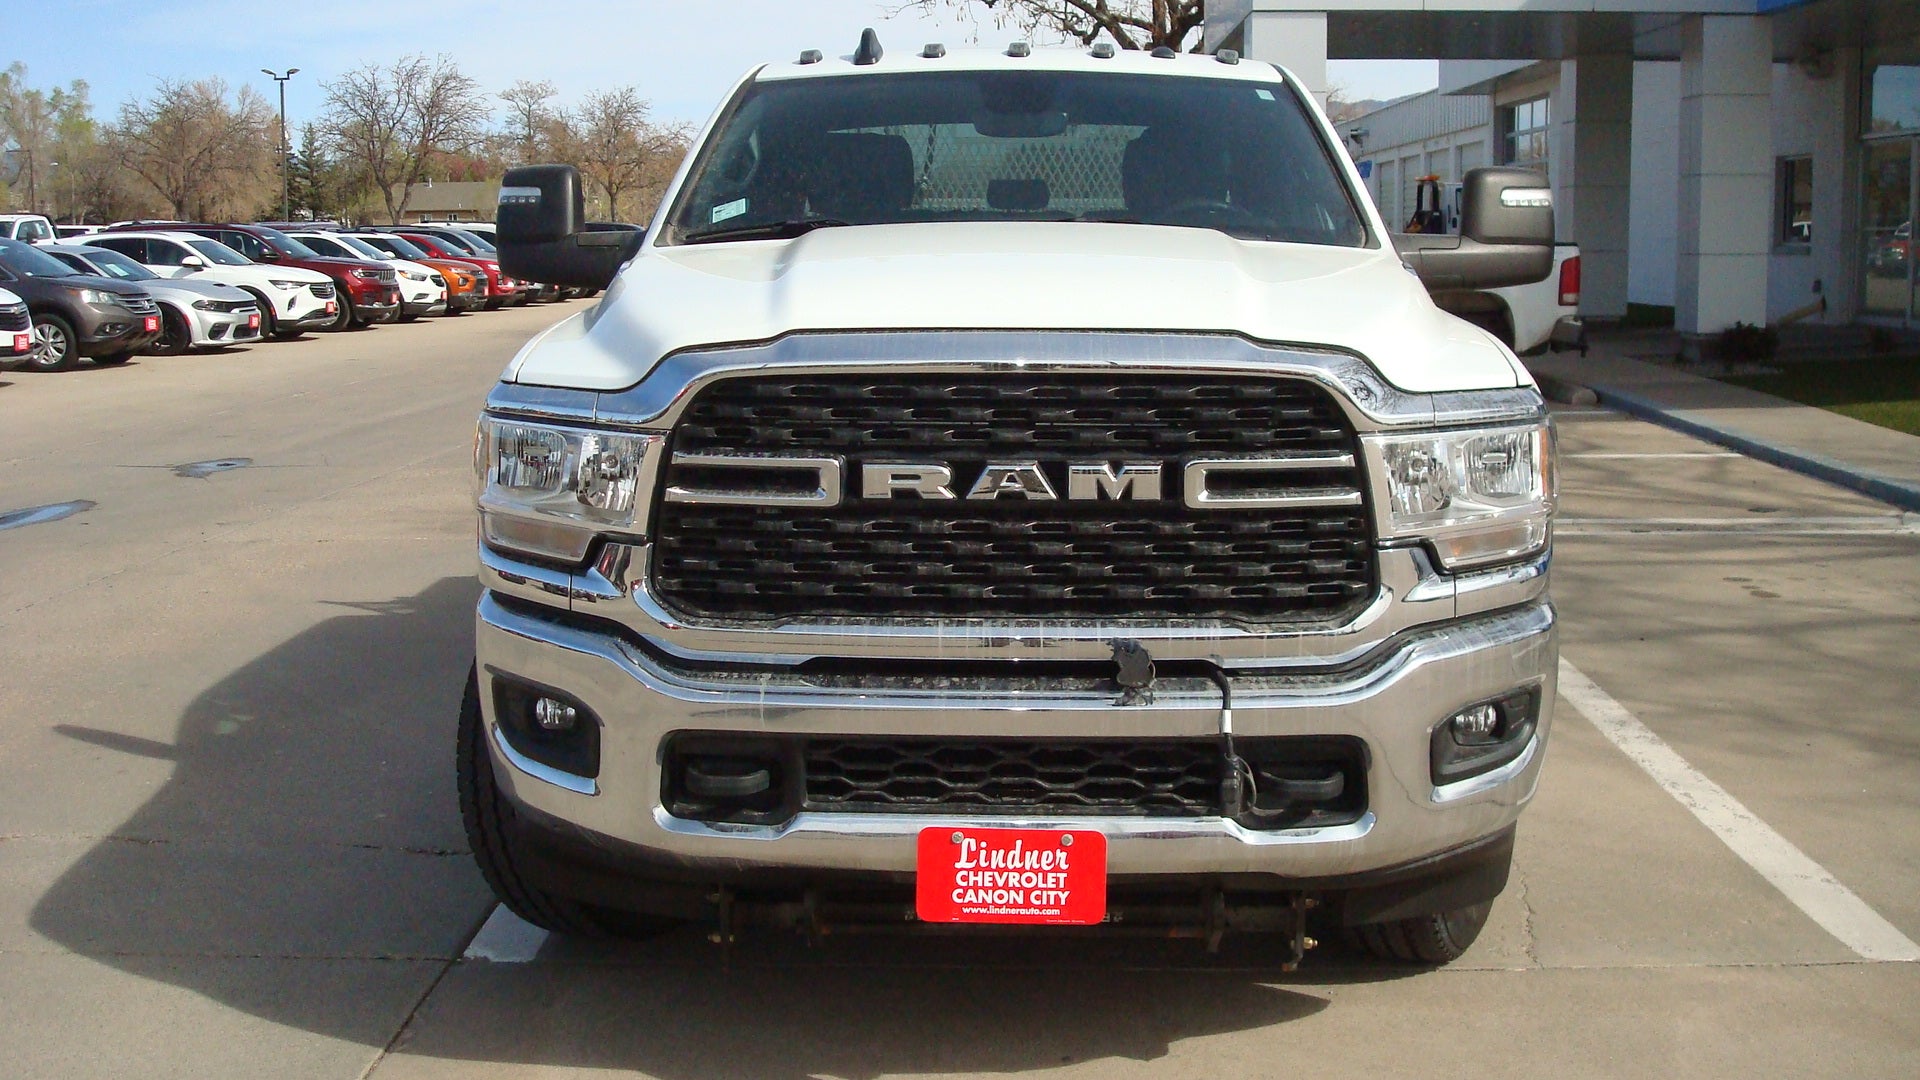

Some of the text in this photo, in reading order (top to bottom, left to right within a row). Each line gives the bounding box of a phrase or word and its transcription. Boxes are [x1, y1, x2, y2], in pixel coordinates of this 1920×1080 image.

[862, 461, 1163, 499] RAM
[954, 838, 1070, 871] Lindner
[955, 870, 1068, 889] CHEVROLET
[952, 888, 1071, 906] CANON CITY
[962, 905, 1061, 916] www.lindnerauto.com
